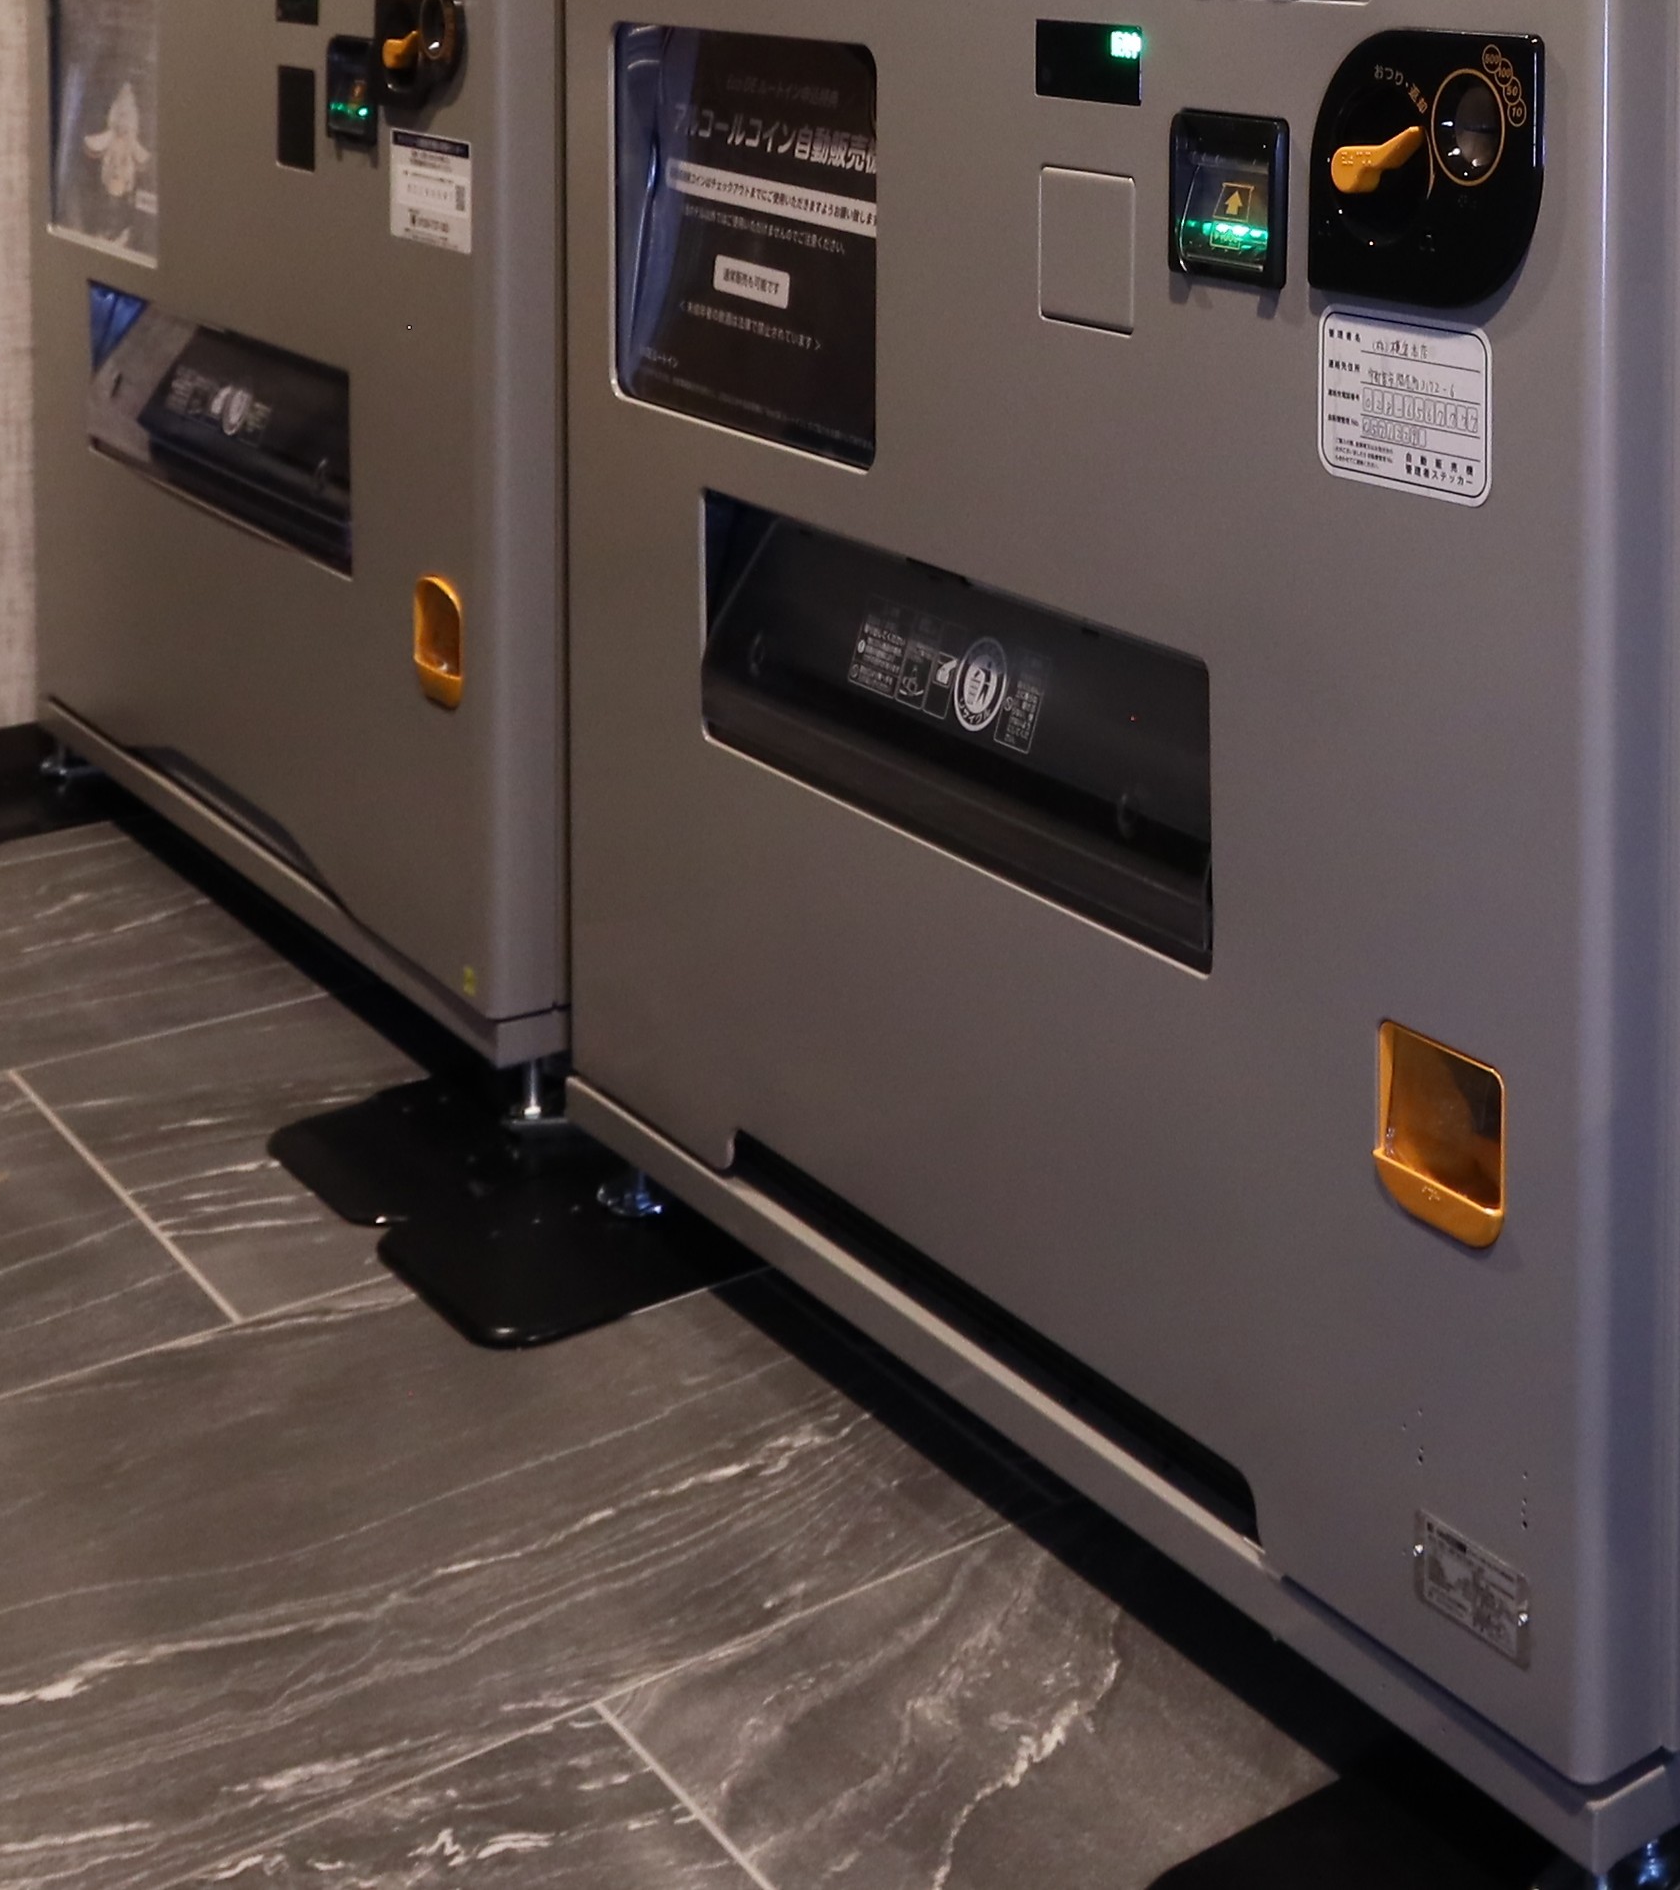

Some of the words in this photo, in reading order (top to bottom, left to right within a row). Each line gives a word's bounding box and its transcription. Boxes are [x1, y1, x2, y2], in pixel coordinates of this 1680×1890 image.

[1498, 67, 1512, 79] 100
[1506, 85, 1518, 96] 50
[1511, 106, 1523, 118] 10
